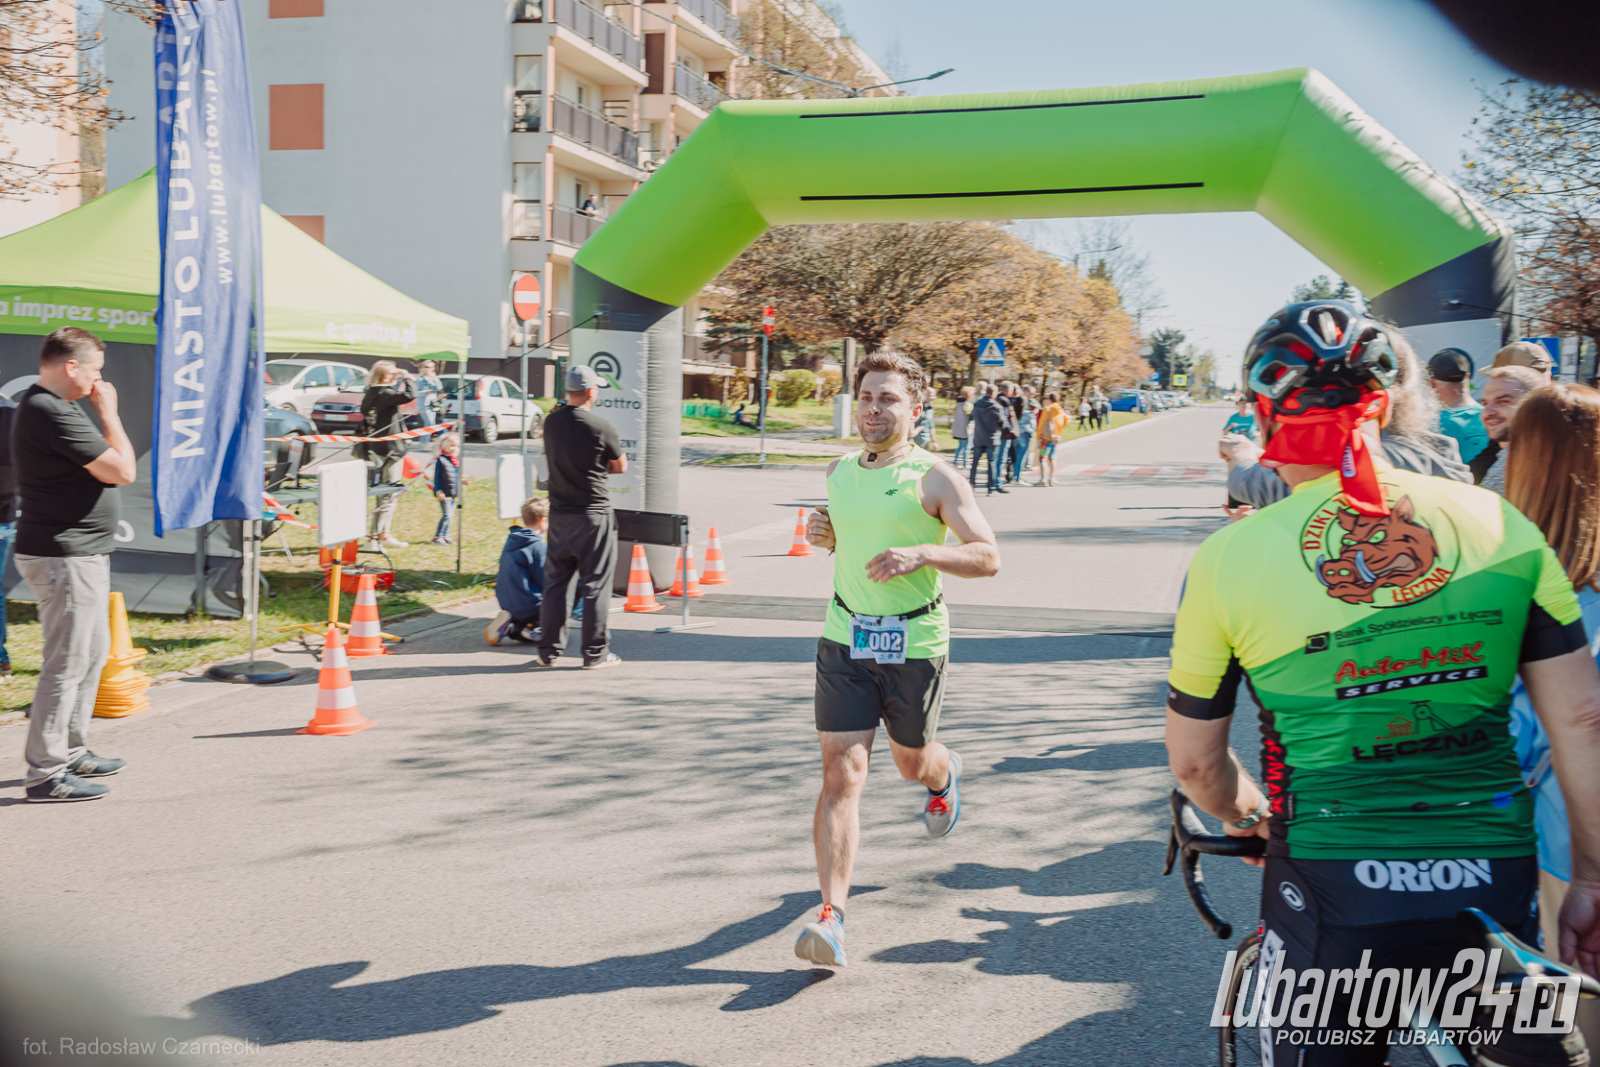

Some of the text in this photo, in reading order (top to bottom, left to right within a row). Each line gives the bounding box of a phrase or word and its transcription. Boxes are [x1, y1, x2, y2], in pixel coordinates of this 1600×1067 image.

[201, 68, 233, 286] www.lubartow.pl
[13, 295, 94, 323] imprez
[170, 255, 206, 460] MIASTO
[1303, 508, 1337, 551] DZIKI
[1343, 667, 1483, 698] SERVICE
